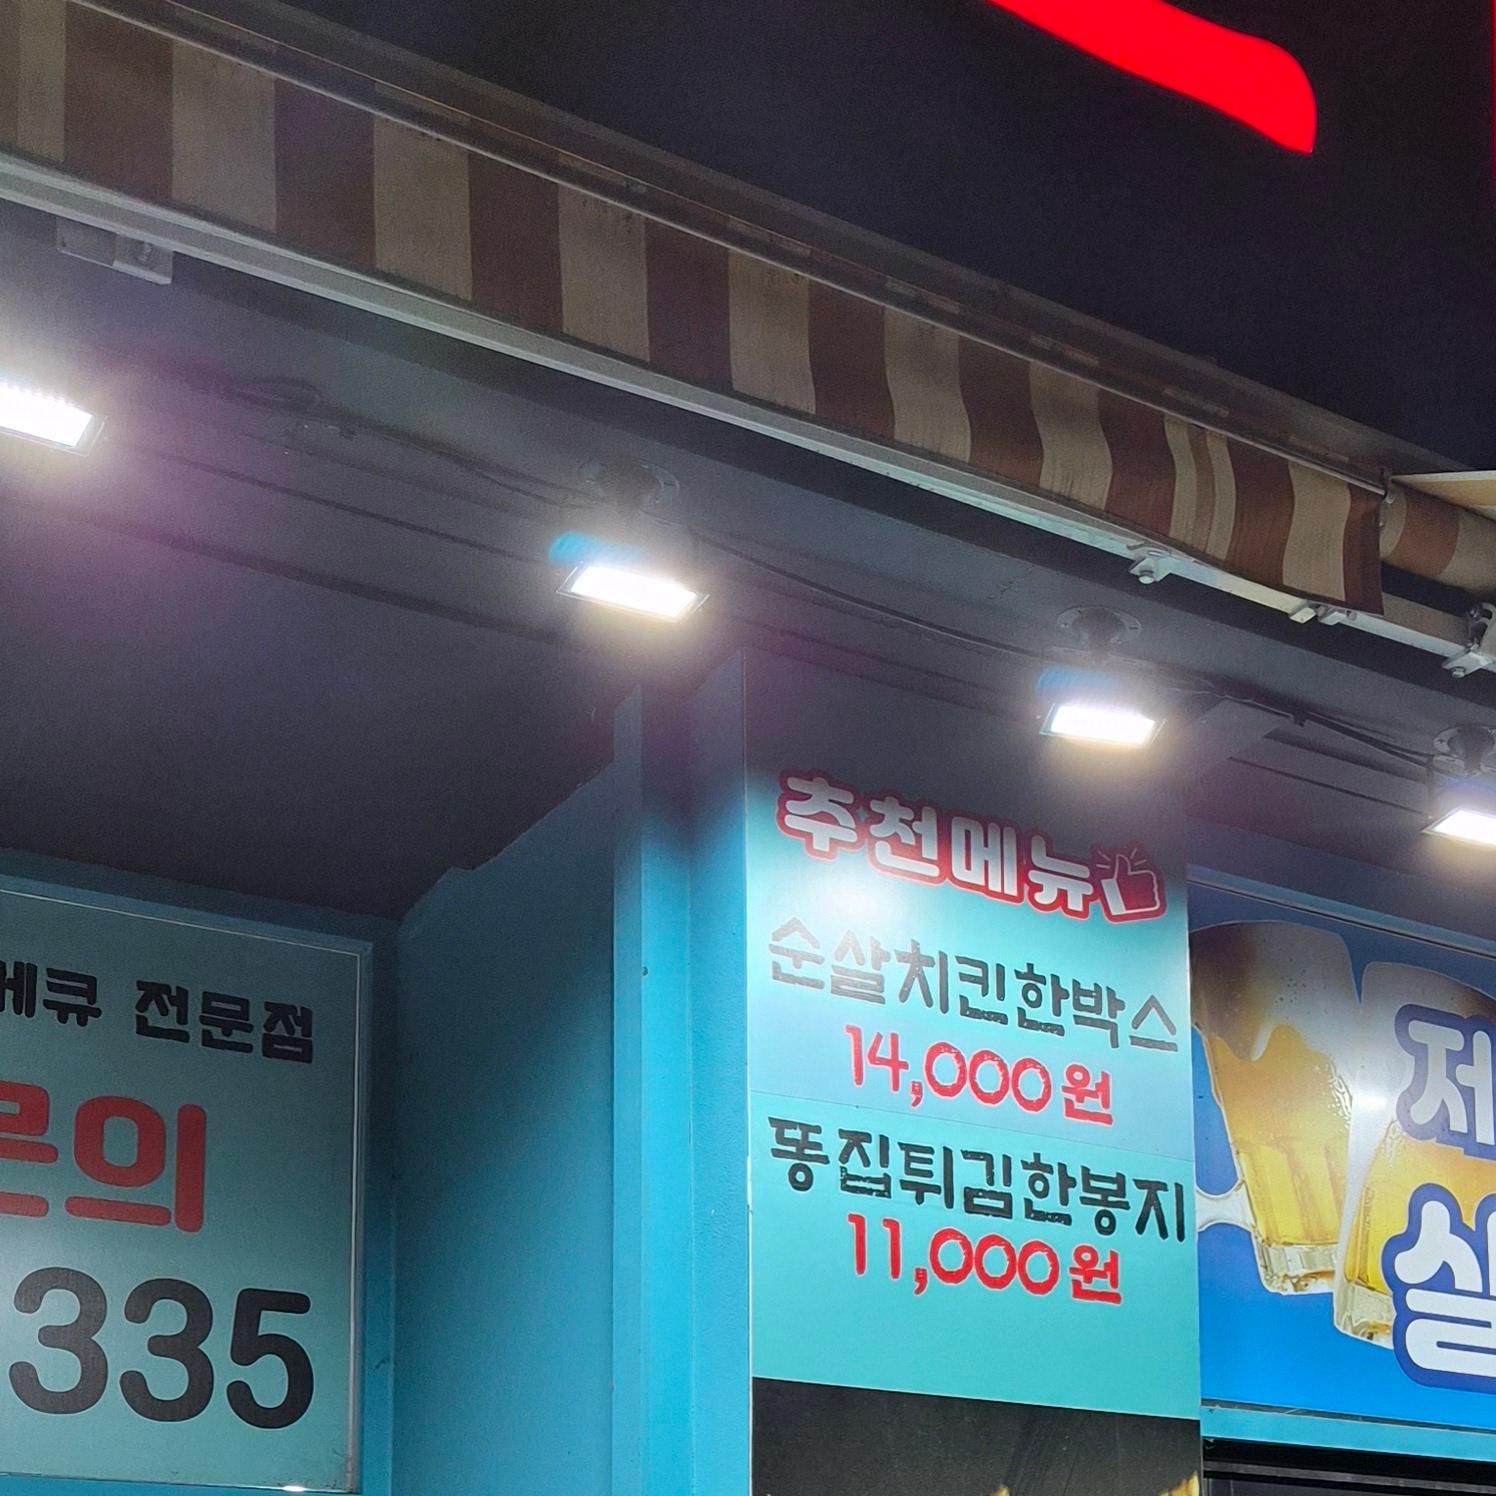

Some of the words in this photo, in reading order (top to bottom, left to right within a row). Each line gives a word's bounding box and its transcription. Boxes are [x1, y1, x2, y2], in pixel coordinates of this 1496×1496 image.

[780, 772, 1096, 918] 추천메뉴
[134, 979, 314, 1064] 전문점
[768, 916, 1178, 1052] 순살치킨한박스
[845, 1023, 1114, 1126] 14,000원
[768, 1115, 1186, 1243] 똥집튀김한봉지
[846, 1212, 1123, 1305] 11,000원
[8, 1266, 315, 1430] 335
